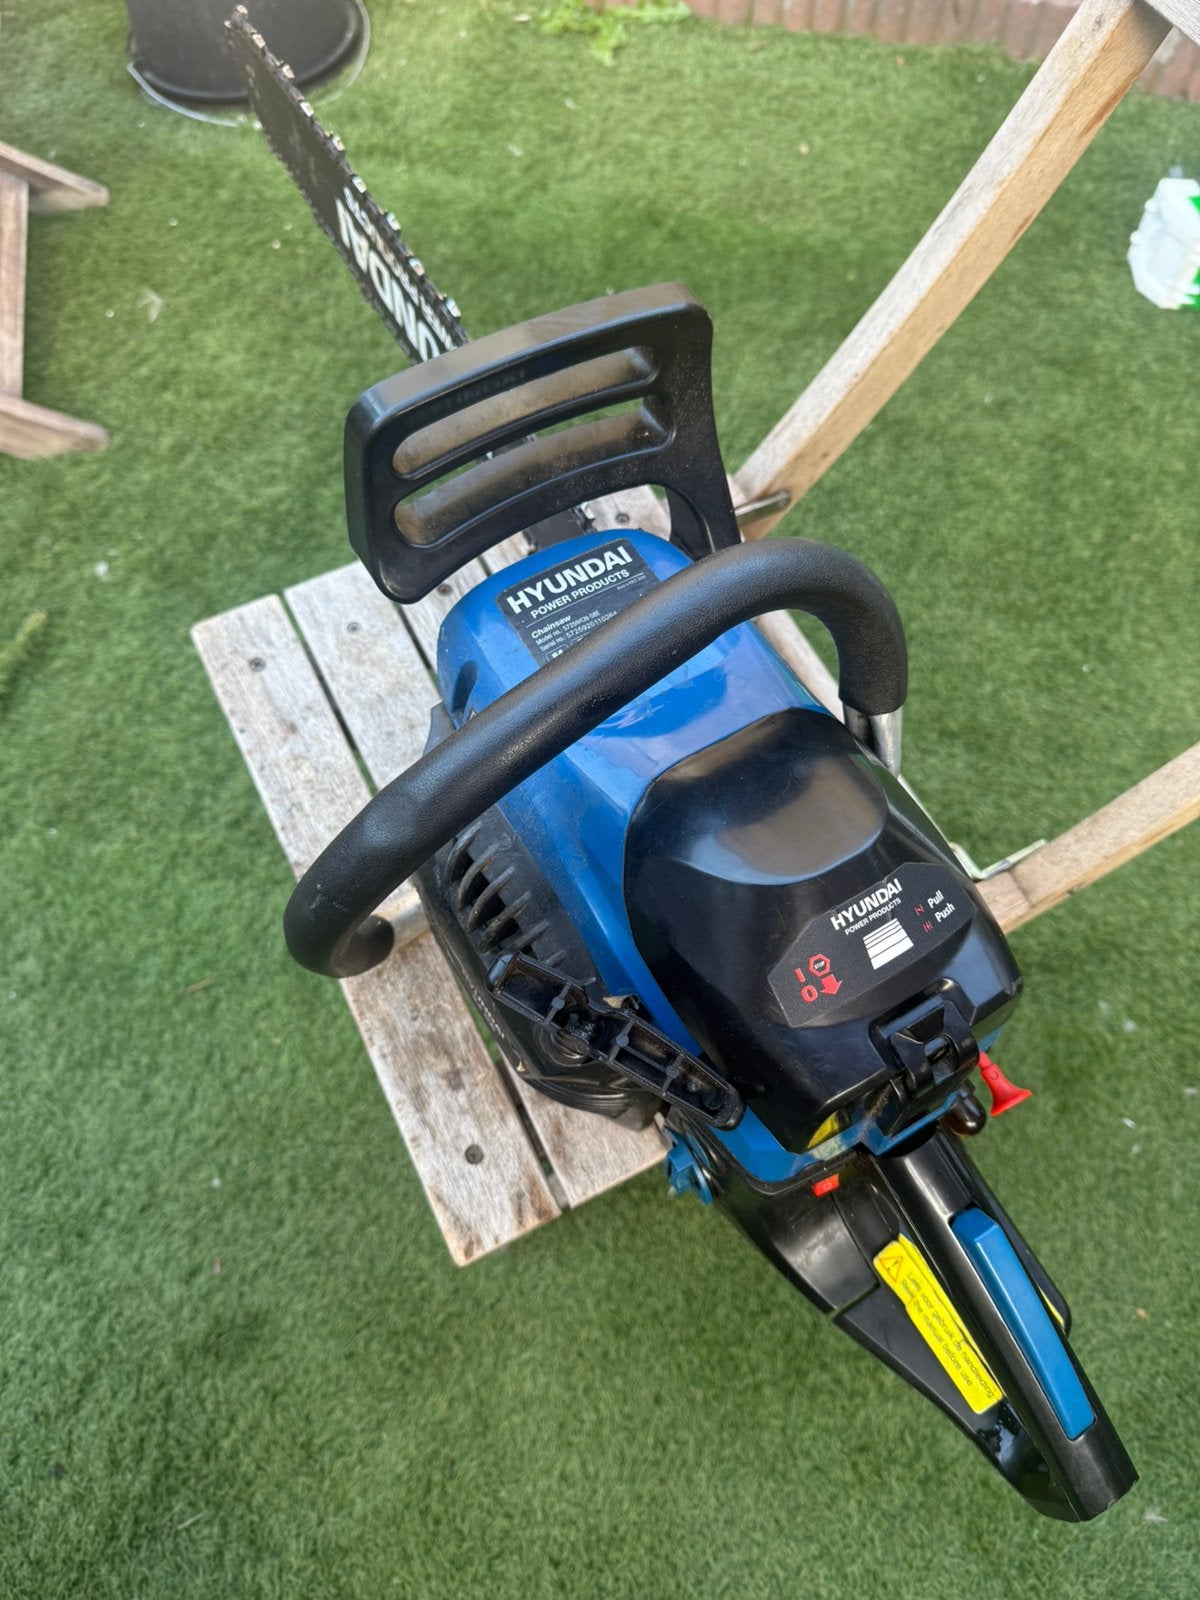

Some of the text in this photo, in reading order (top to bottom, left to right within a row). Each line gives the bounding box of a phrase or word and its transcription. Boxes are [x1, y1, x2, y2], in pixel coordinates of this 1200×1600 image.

[335, 198, 441, 362] UNDAI
[506, 546, 633, 614] HYUNDAI
[530, 593, 572, 618] POWER
[573, 569, 630, 600] PRODUCTS
[531, 615, 571, 639] Chainsaw
[536, 633, 553, 645] Model
[540, 641, 557, 652] Serial
[830, 878, 903, 931] HYUNDAI
[844, 897, 902, 936] POWER PRODUCTS
[927, 890, 944, 909] Pull
[934, 902, 956, 922] Push
[922, 1314, 943, 1344] manual
[942, 1343, 962, 1371] before
[960, 1370, 973, 1387] use
[932, 1308, 956, 1338] gebruik
[960, 1346, 995, 1399] handleiding
